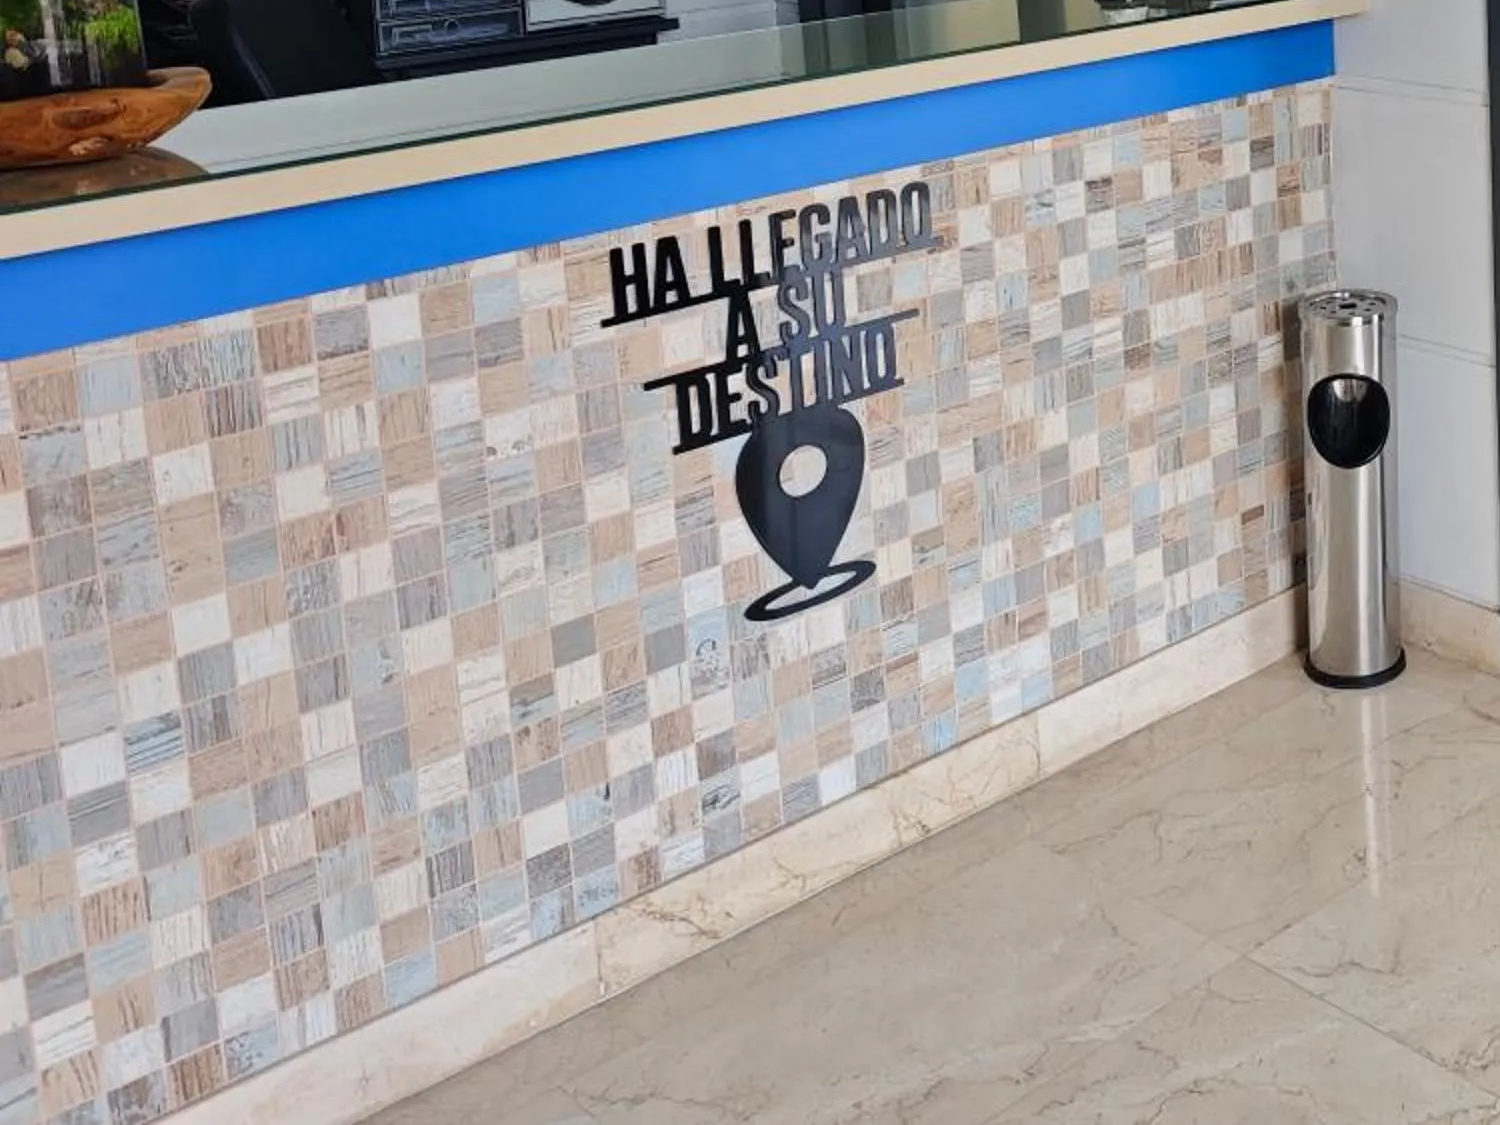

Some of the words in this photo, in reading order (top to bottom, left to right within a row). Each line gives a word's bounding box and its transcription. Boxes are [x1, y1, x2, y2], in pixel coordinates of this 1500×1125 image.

[609, 235, 691, 319] HA
[708, 181, 934, 295] LLEGADO
[726, 288, 761, 362] A
[777, 266, 848, 342] SU
[675, 324, 899, 444] DESTINO
